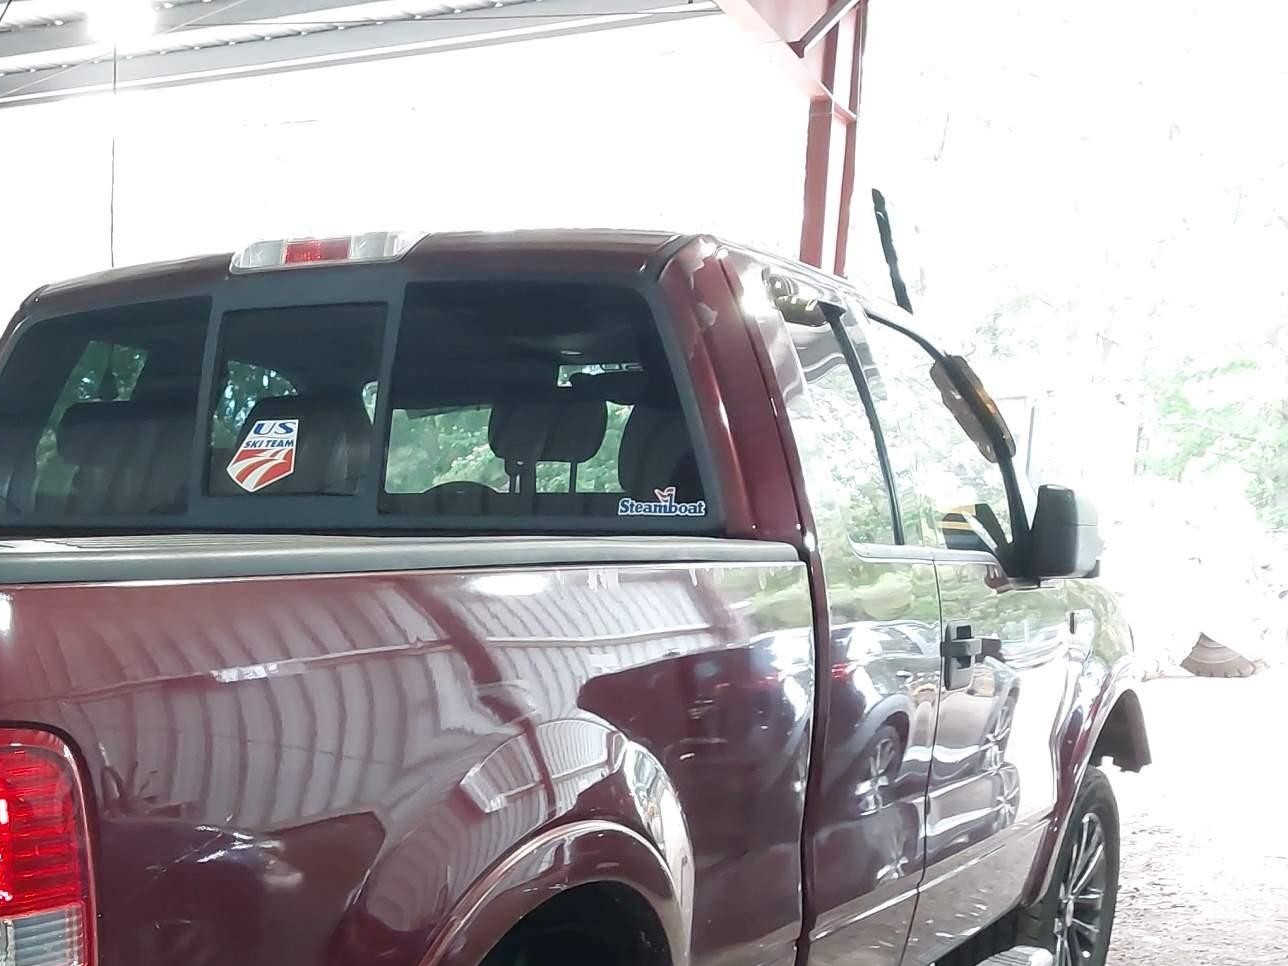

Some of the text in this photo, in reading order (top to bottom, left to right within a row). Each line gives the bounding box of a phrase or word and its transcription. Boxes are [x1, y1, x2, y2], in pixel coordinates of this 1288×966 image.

[253, 421, 297, 436] US
[242, 439, 294, 449] SKI TEAM
[618, 495, 705, 515] Steamboat
